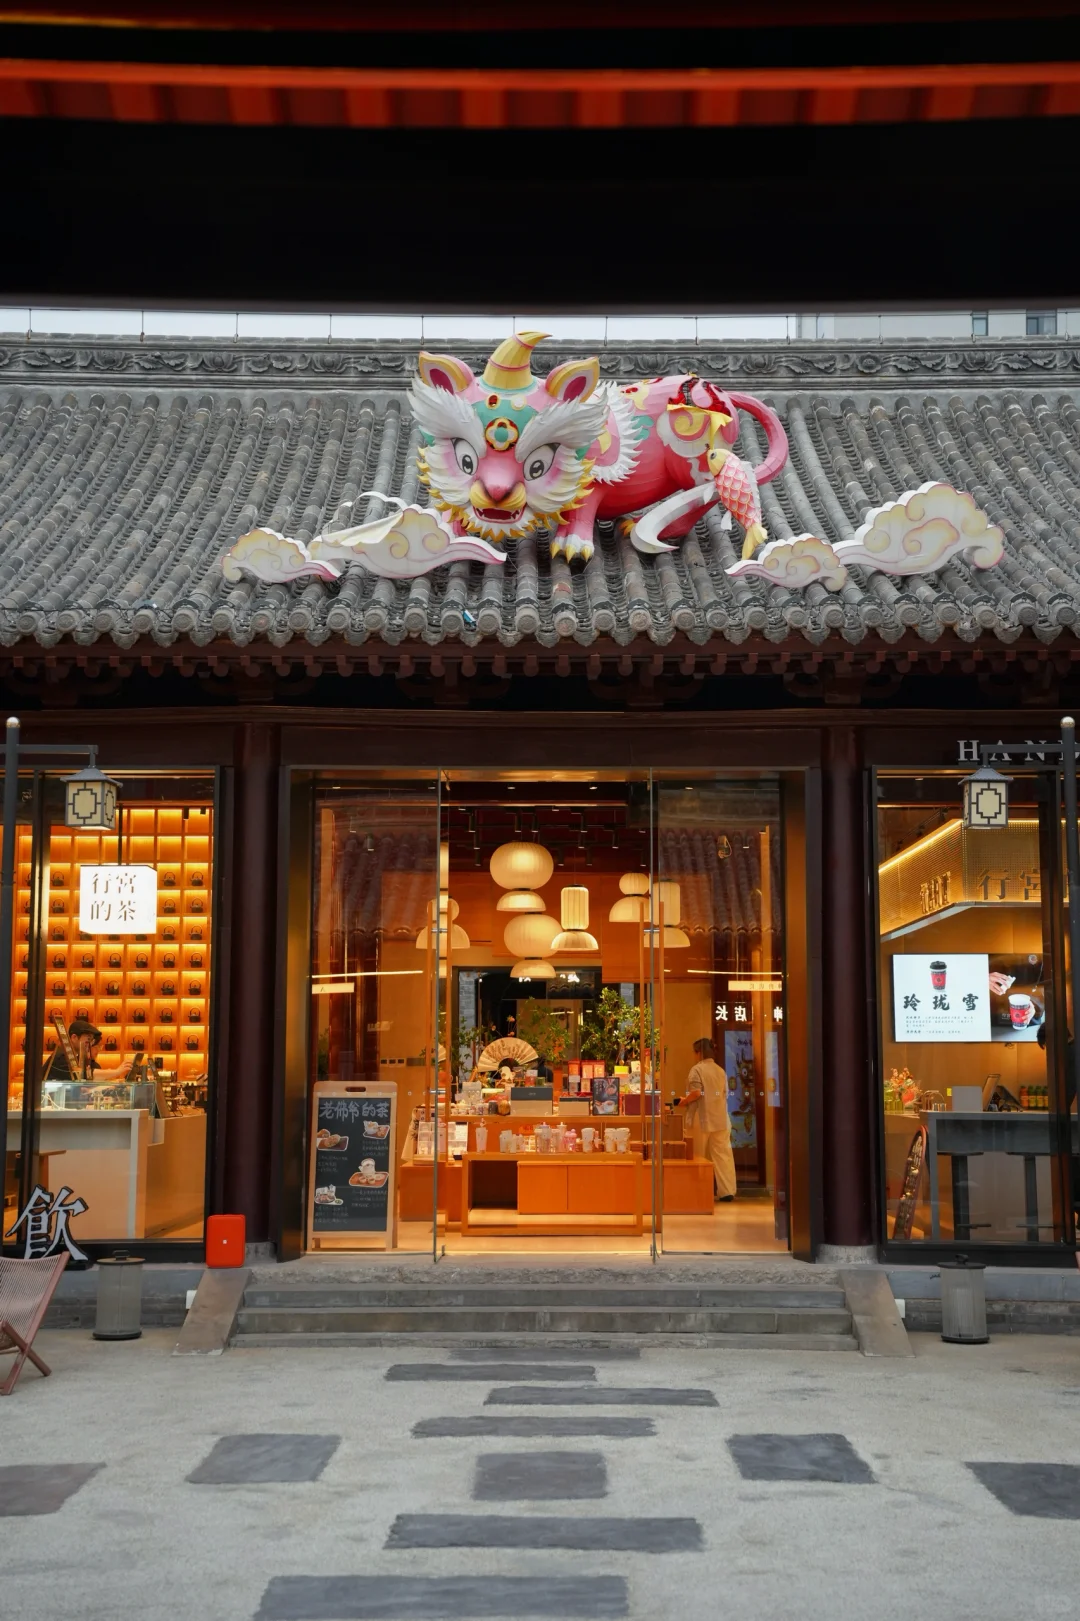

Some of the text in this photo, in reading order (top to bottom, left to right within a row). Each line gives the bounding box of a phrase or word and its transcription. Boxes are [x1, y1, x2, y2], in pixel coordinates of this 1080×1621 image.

[91, 900, 136, 922] 的茶
[903, 993, 979, 1012] 玲珑雪
[319, 1100, 389, 1123] 老佛爷的茶
[5, 1184, 89, 1261] 飲
